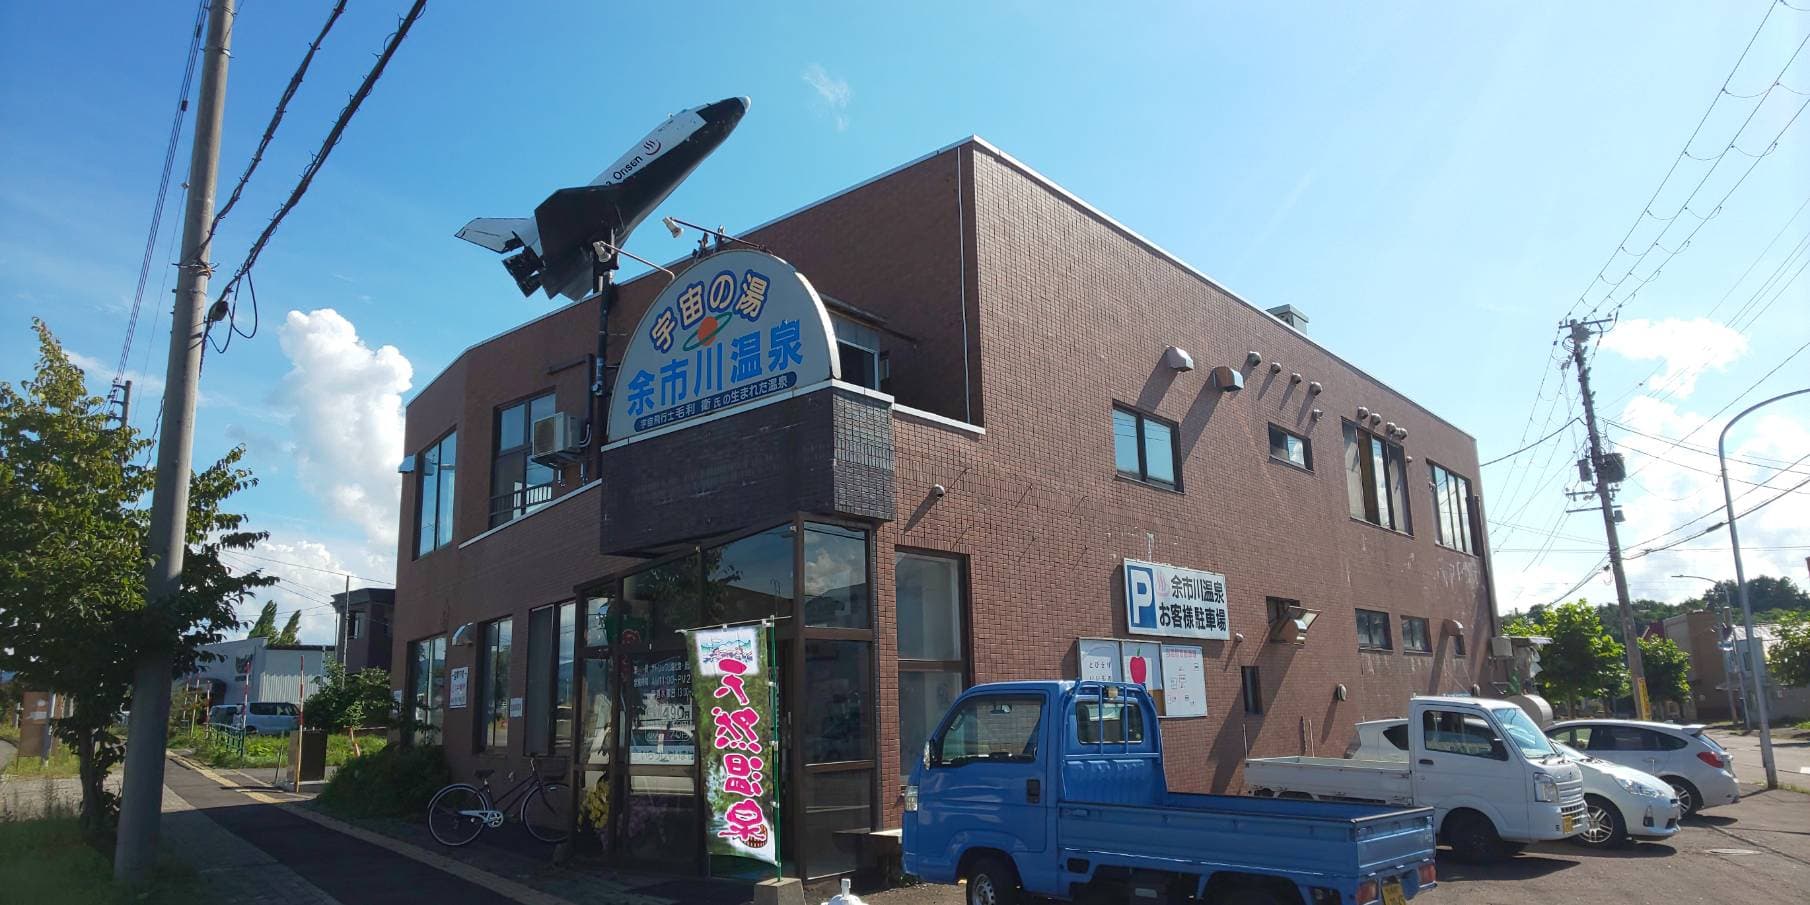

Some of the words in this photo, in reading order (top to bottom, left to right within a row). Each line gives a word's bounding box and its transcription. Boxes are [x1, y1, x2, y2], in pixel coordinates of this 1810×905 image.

[612, 154, 643, 180] Onsen
[650, 269, 771, 353] 宇宙の湯
[627, 319, 803, 417] 余市川温泉
[1130, 568, 1154, 624] P
[1170, 574, 1225, 604] 余市川温泉
[1159, 602, 1227, 632] お客様駐車場
